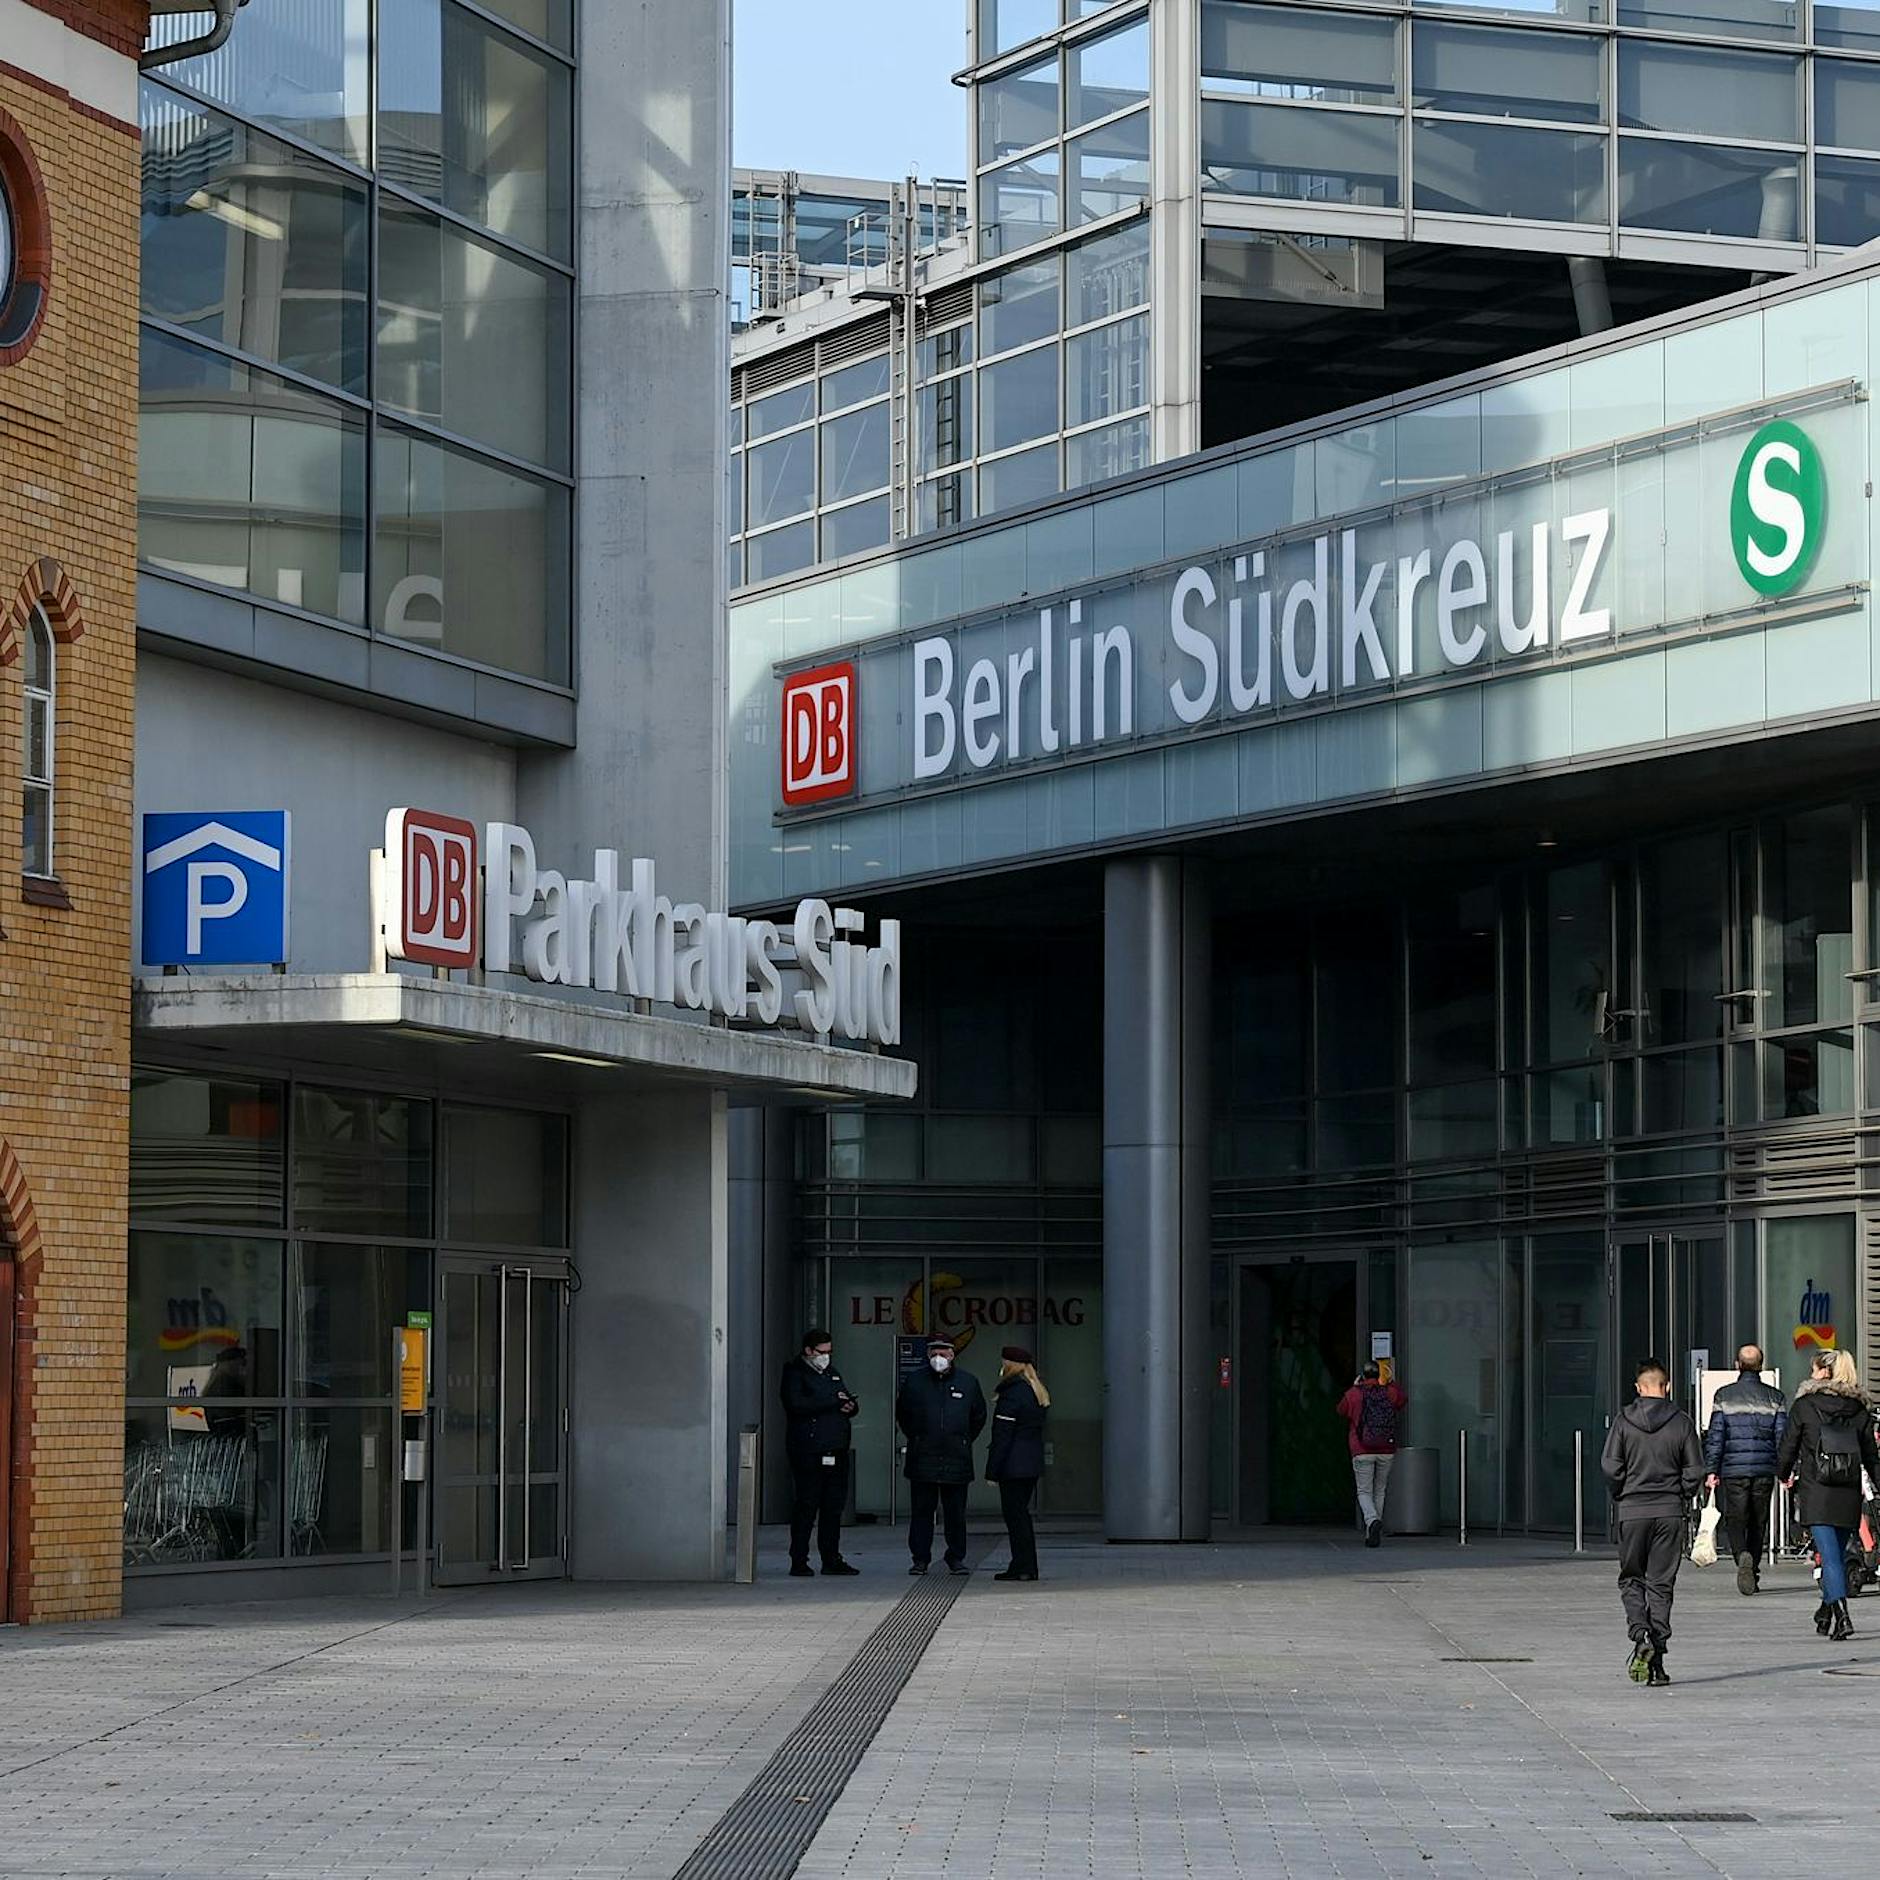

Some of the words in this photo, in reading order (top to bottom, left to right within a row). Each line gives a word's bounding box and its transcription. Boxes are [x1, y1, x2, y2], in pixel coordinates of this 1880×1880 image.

[1745, 441, 1806, 577] S
[913, 598, 1133, 780] Berlin
[1169, 507, 1612, 725] Südkreuz
[790, 683, 845, 783] DB
[186, 860, 248, 956] P
[411, 832, 467, 941] DB
[485, 821, 783, 1025] Parkhaus
[793, 898, 901, 1046] Süd
[850, 1296, 895, 1326] LE
[937, 1295, 1086, 1327] CROBAG
[1799, 1279, 1830, 1325] dm
